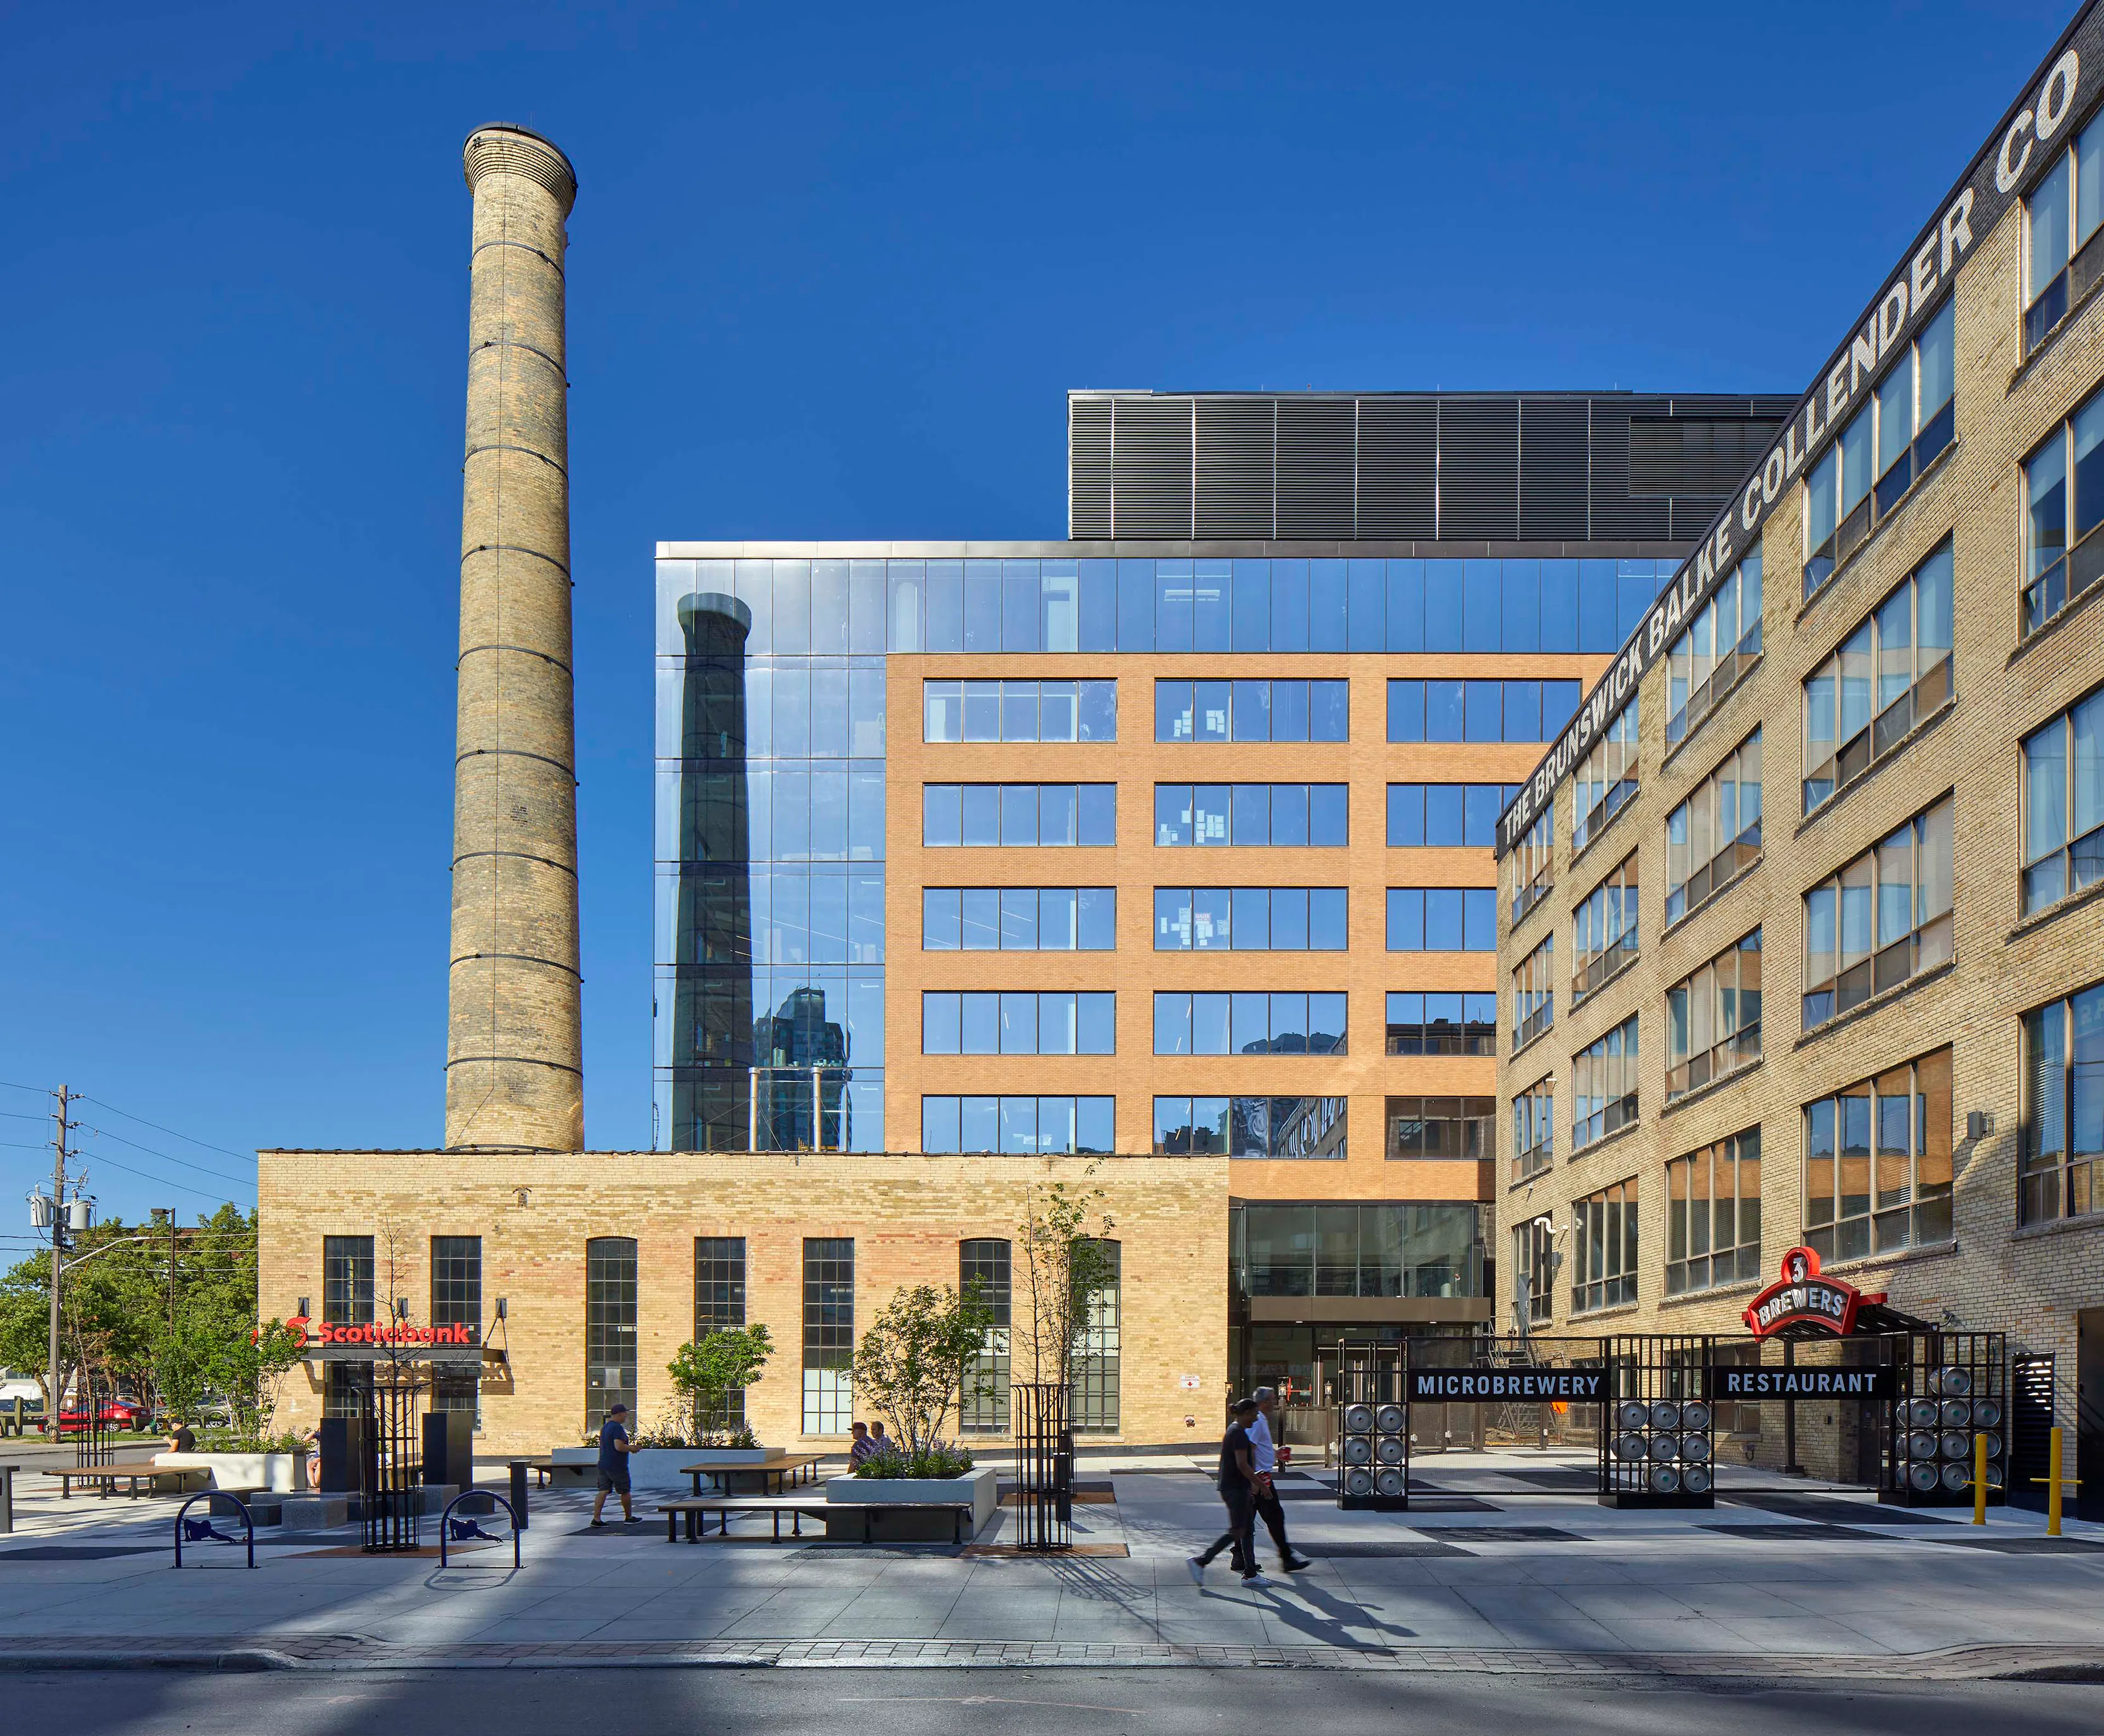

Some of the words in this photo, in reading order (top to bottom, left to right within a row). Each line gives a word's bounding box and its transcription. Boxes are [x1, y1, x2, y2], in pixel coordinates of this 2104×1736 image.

[1504, 786, 1531, 845] THE
[1534, 632, 1643, 809] BRUNSWICK
[1649, 510, 1732, 658] BALKE
[1742, 187, 1974, 531] COLLENDER
[1996, 49, 2080, 193] CO
[1792, 1257, 1805, 1283] 3
[1758, 1287, 1843, 1326] BREWERS
[318, 1321, 471, 1344] Scotiabank
[1417, 1376, 1599, 1395] MICROBREWERY
[1728, 1373, 1877, 1392] RESTAURANT
